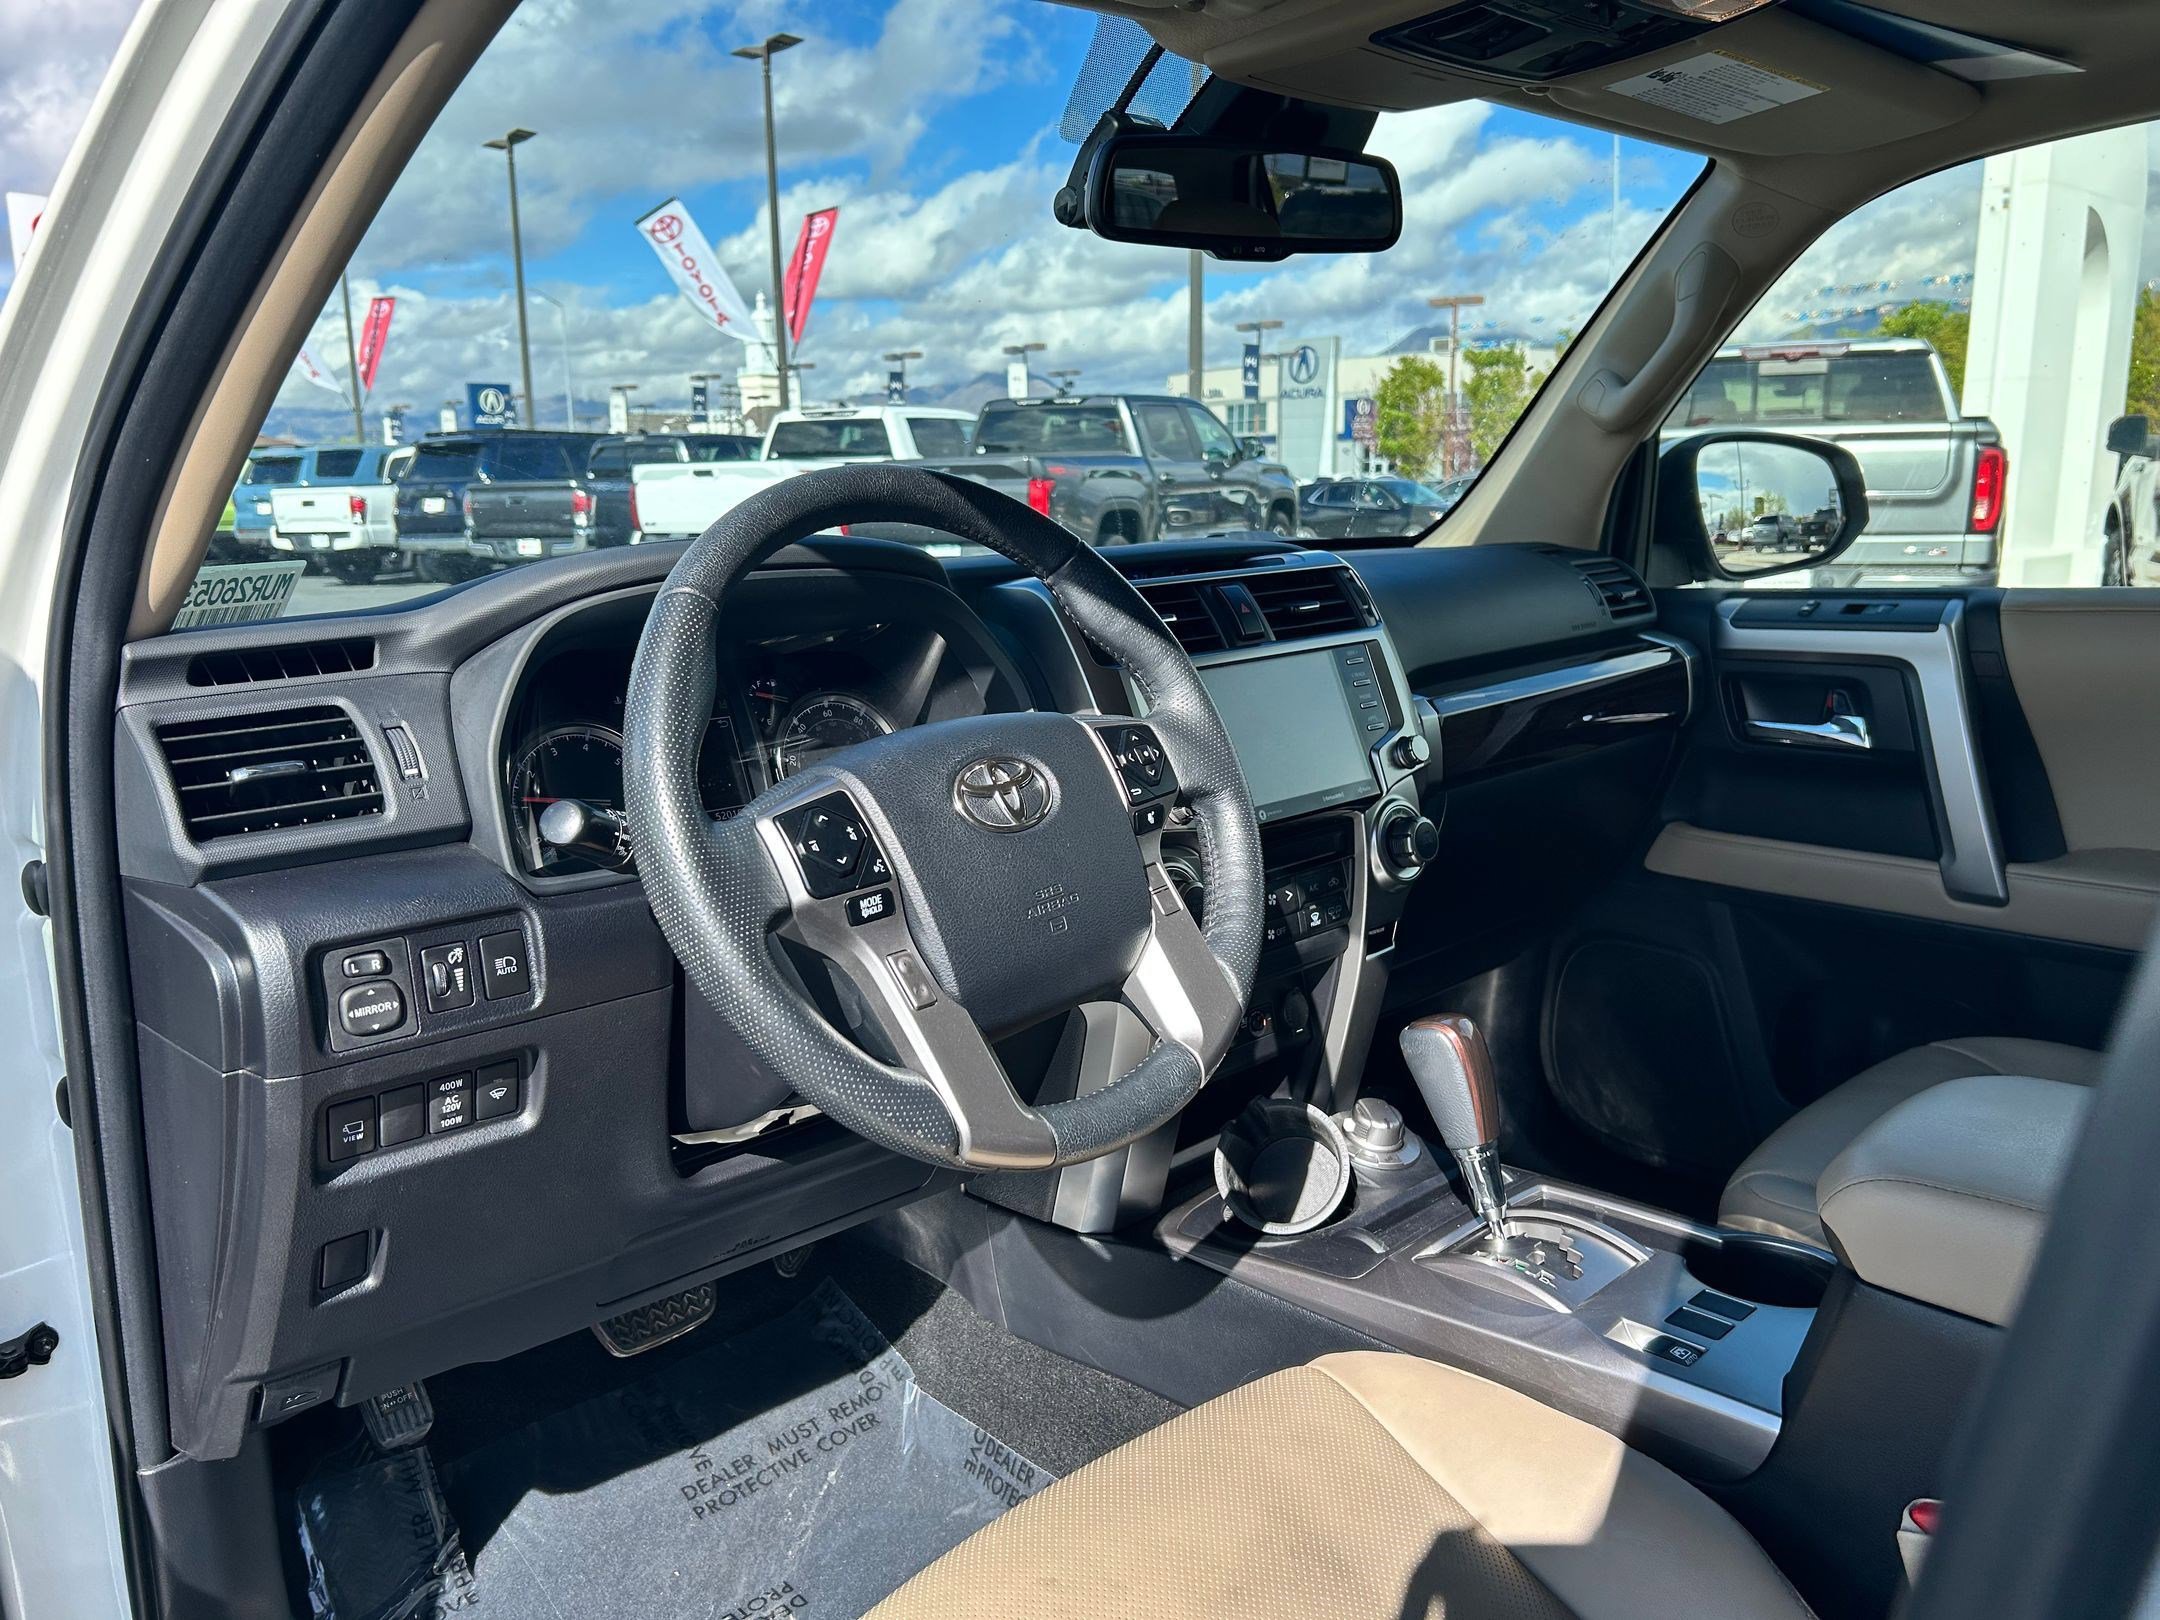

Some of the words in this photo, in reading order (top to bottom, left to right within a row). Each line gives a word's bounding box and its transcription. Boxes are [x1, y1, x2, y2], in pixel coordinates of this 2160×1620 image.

[673, 242, 731, 317] TOYOTA
[1279, 387, 1324, 399] ACURA
[822, 709, 833, 718] 60
[853, 715, 864, 727] 80
[550, 747, 559, 757] 3
[789, 755, 797, 767] 20
[859, 893, 883, 910] MODE
[868, 904, 883, 916] HOLD
[350, 963, 359, 974] L
[371, 959, 381, 970] R
[496, 965, 518, 976] AUTO
[353, 1002, 393, 1019] MIRROR
[439, 1078, 463, 1092] 400W
[444, 1095, 460, 1105] AC
[441, 1102, 462, 1114] 120V
[440, 1115, 463, 1128] 100W
[343, 1133, 364, 1143] VIEW
[381, 1385, 404, 1401] PUSH
[681, 1454, 757, 1501] DEALER
[767, 1416, 821, 1456] MUST
[828, 1366, 905, 1423] REMOVE
[693, 1448, 813, 1520] PROTECTIVE
[817, 1411, 881, 1453] COVER
[984, 1437, 1035, 1489] DEALER
